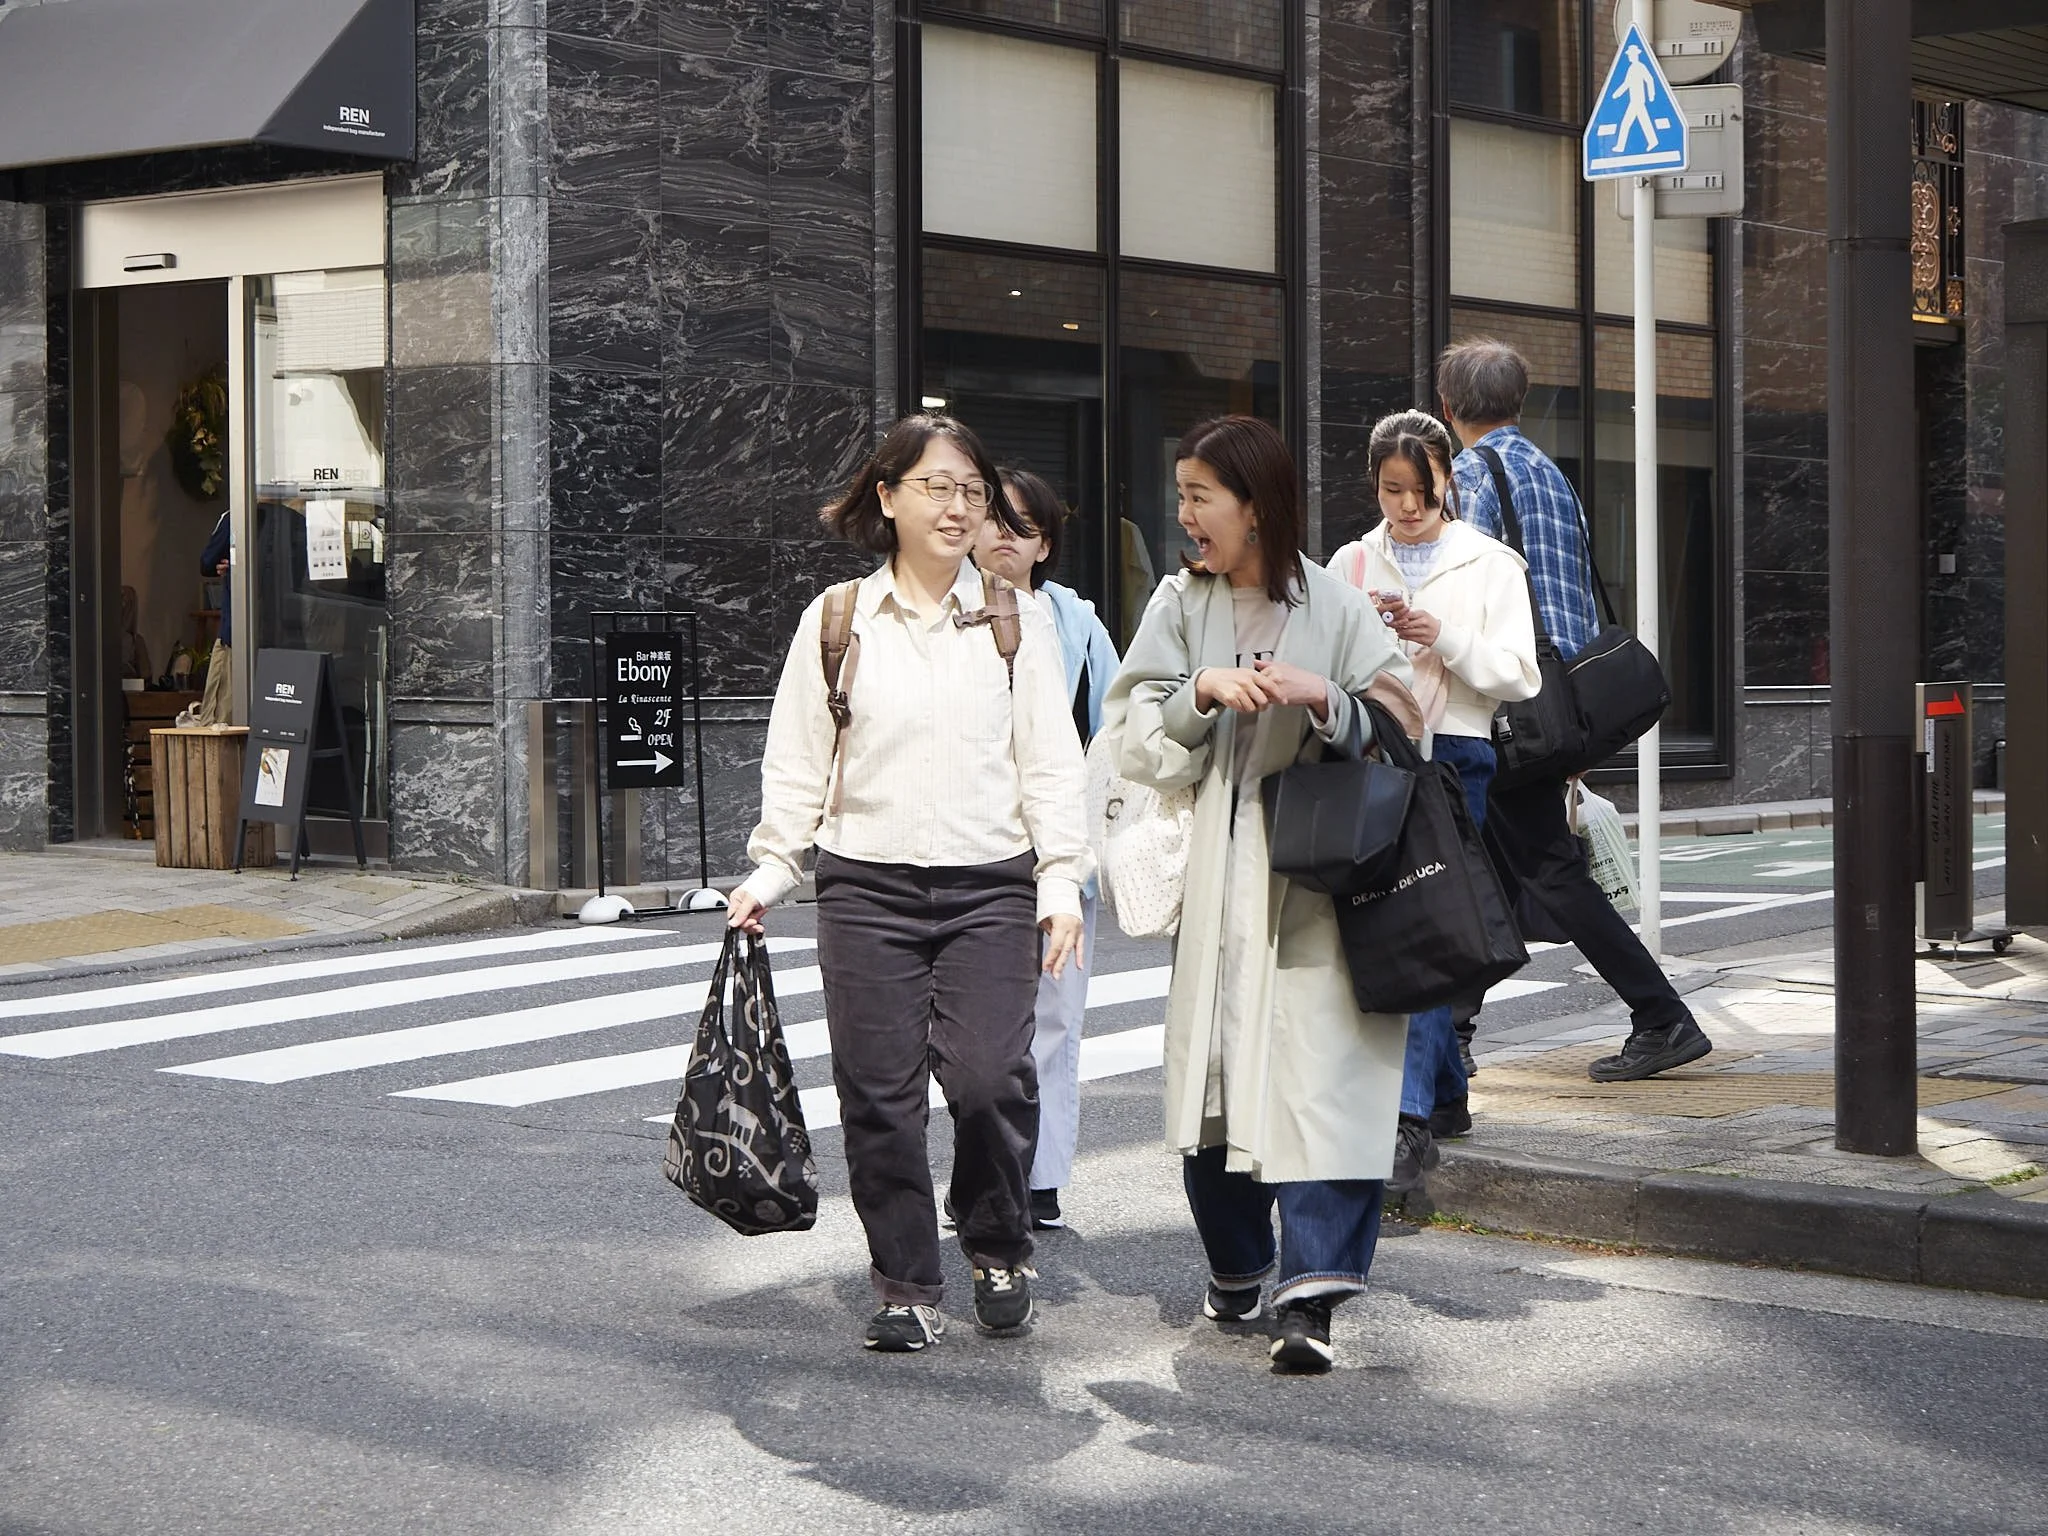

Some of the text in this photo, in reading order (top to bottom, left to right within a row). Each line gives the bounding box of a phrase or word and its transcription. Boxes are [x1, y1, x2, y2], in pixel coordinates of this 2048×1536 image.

[339, 106, 370, 124] REN
[313, 467, 339, 481] REN
[617, 657, 671, 688] Ebony
[275, 683, 295, 695] REN
[618, 693, 672, 704] La Rinascente
[654, 708, 672, 727] 2F
[647, 732, 674, 747] OPEN
